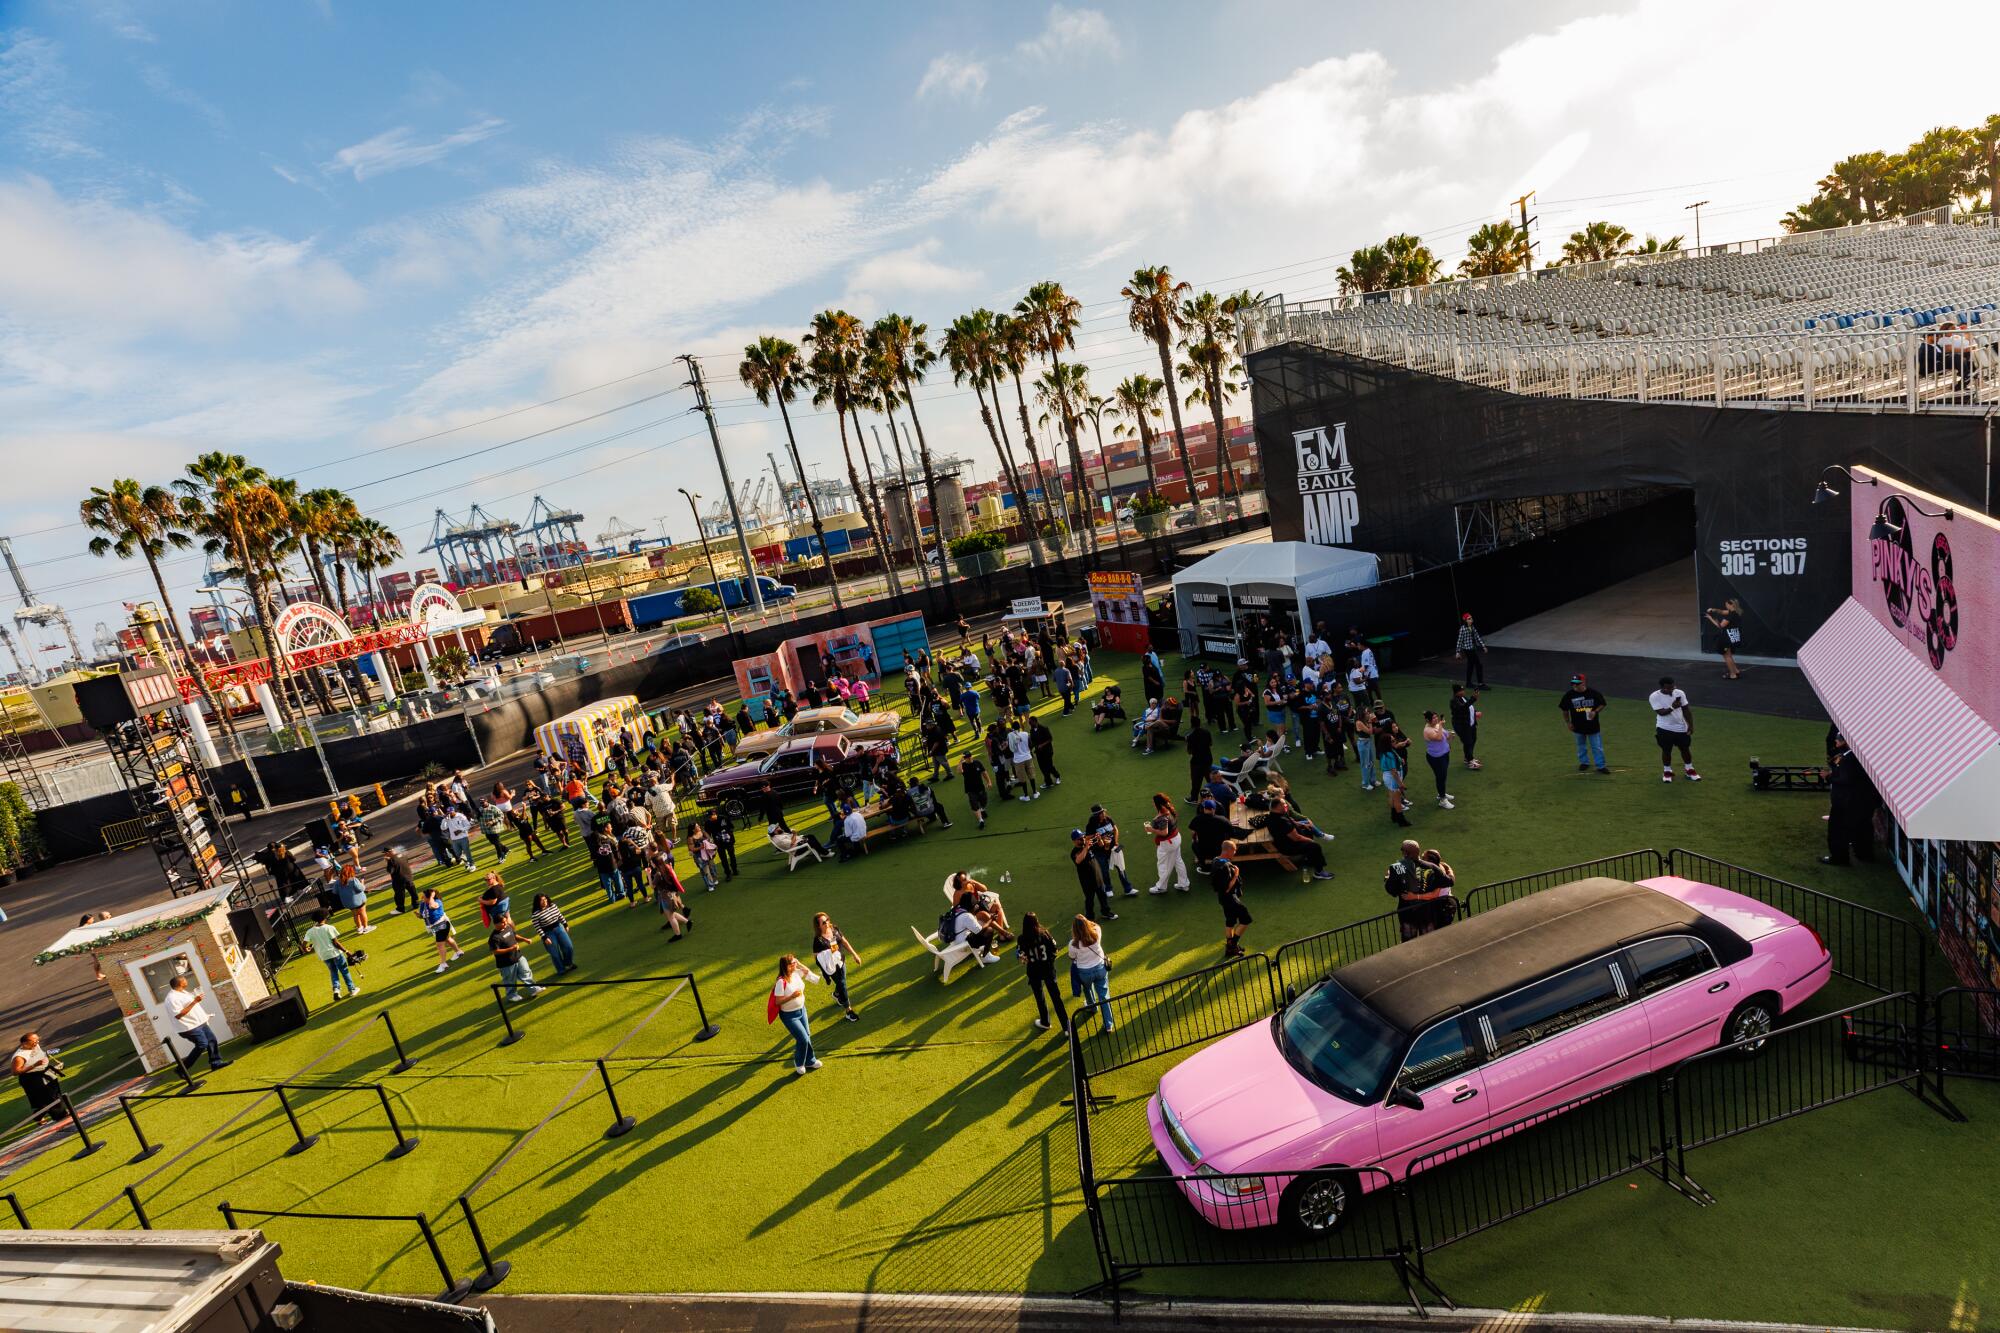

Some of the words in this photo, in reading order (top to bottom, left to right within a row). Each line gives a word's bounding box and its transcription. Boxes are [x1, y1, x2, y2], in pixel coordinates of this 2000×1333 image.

[1292, 423, 1353, 473] F&M
[1298, 471, 1356, 491] BANK
[1302, 490, 1360, 544] AMP
[1720, 538, 1807, 551] SECTIONS
[1721, 553, 1755, 575] 305
[1770, 552, 1806, 575] 307
[1871, 539, 1932, 622] PINKY'S
